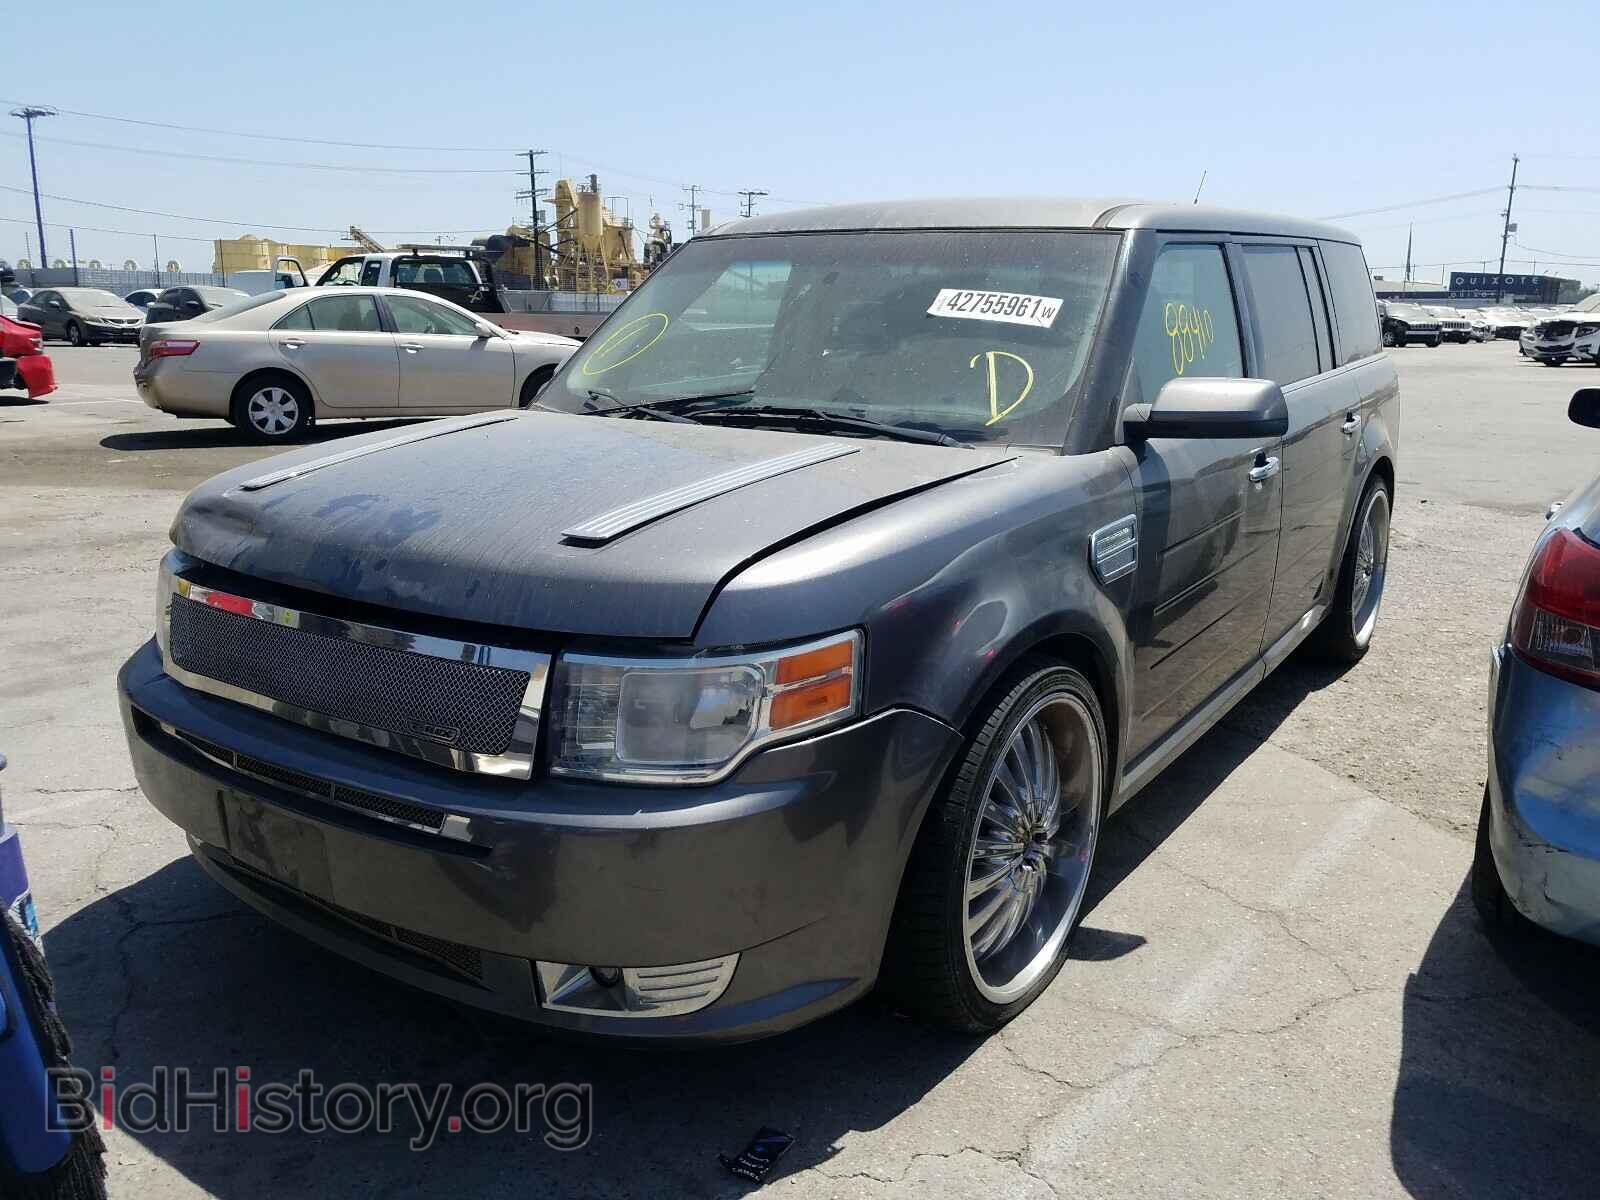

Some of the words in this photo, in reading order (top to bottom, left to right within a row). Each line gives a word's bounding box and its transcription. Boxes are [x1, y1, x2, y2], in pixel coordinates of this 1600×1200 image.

[1455, 276, 1540, 285] QUIXOTE
[947, 291, 1042, 319] 42755961
[969, 351, 1034, 426] D
